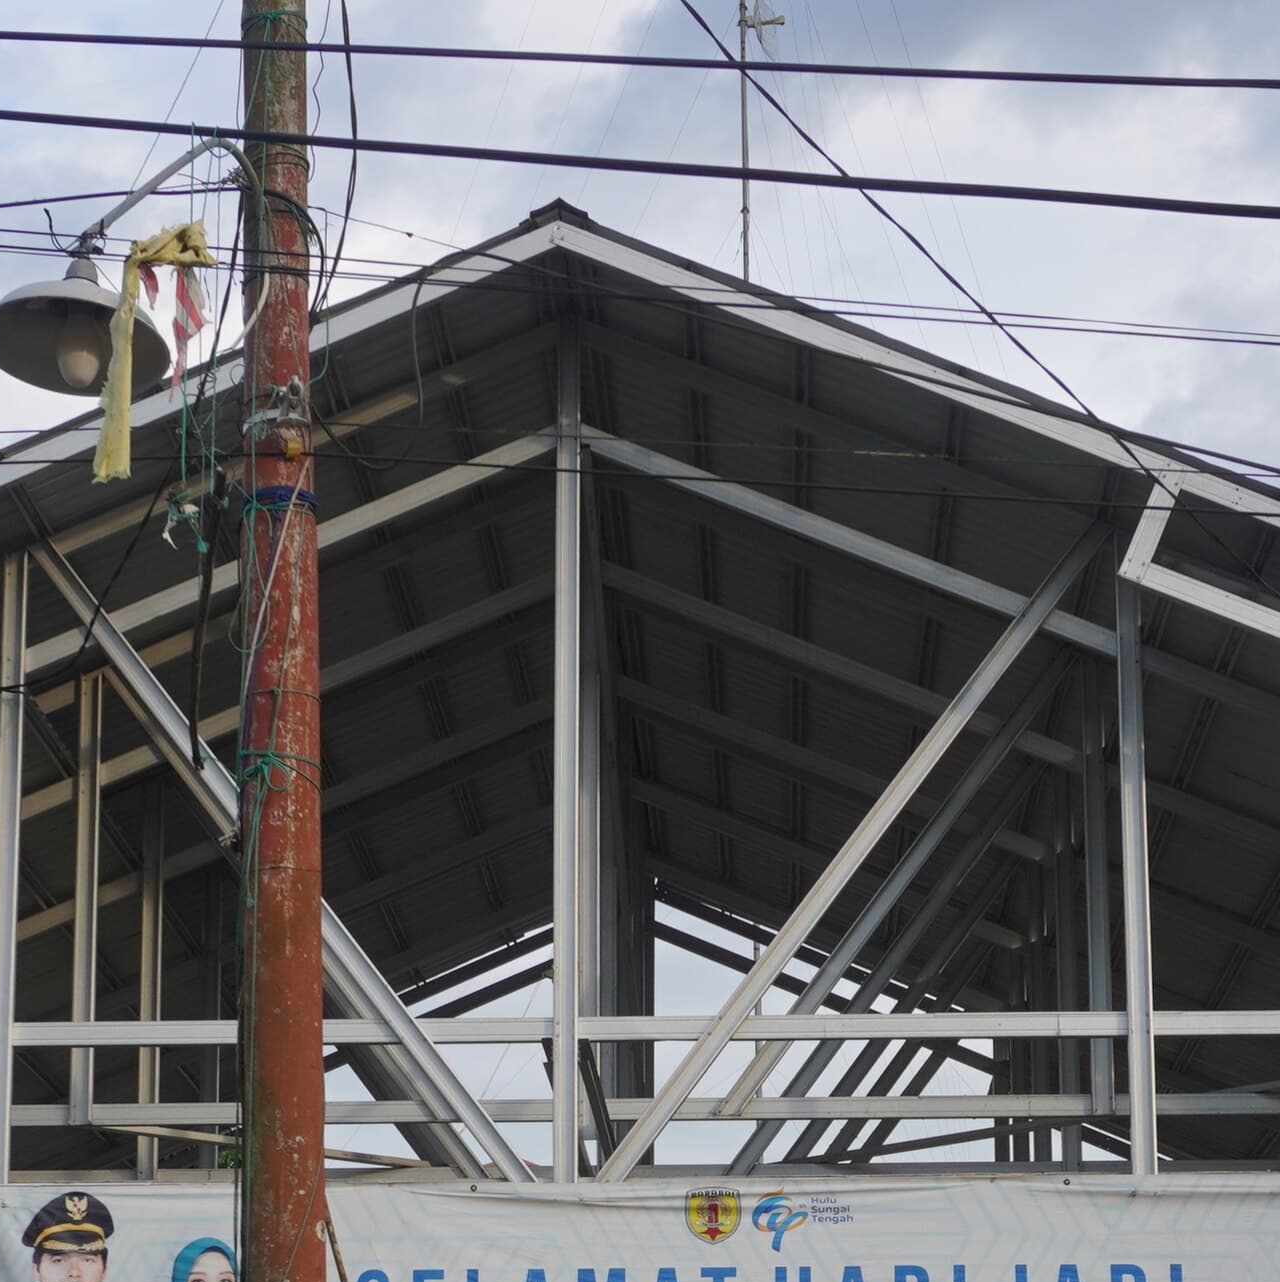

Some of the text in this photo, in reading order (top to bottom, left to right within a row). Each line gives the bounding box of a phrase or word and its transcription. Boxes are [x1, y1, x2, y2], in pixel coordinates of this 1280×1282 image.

[811, 1196, 837, 1204] Hulu
[811, 1205, 850, 1215] Sungai
[811, 1214, 854, 1225] Tengah
